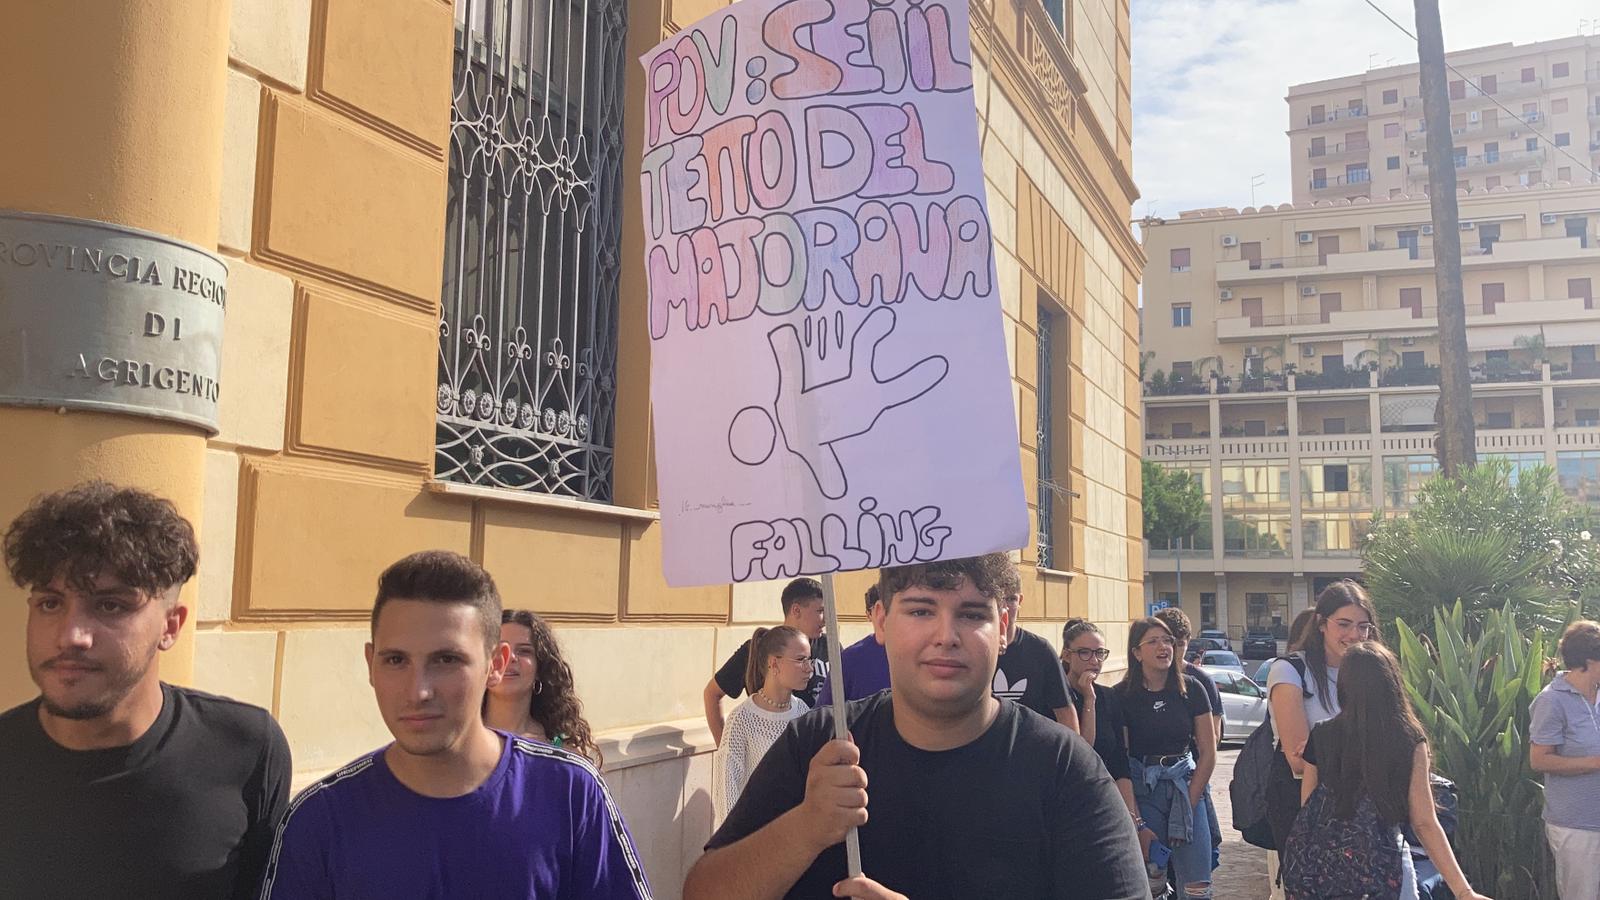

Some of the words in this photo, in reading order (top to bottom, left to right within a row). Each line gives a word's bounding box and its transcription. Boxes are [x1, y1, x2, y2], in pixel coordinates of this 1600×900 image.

[640, 109, 797, 240] TETTO
[804, 101, 955, 204] DEL
[172, 266, 226, 309] REGIO
[648, 195, 993, 341] MAJORANA
[143, 311, 181, 341] DI
[66, 353, 220, 403] AGRIGENTO
